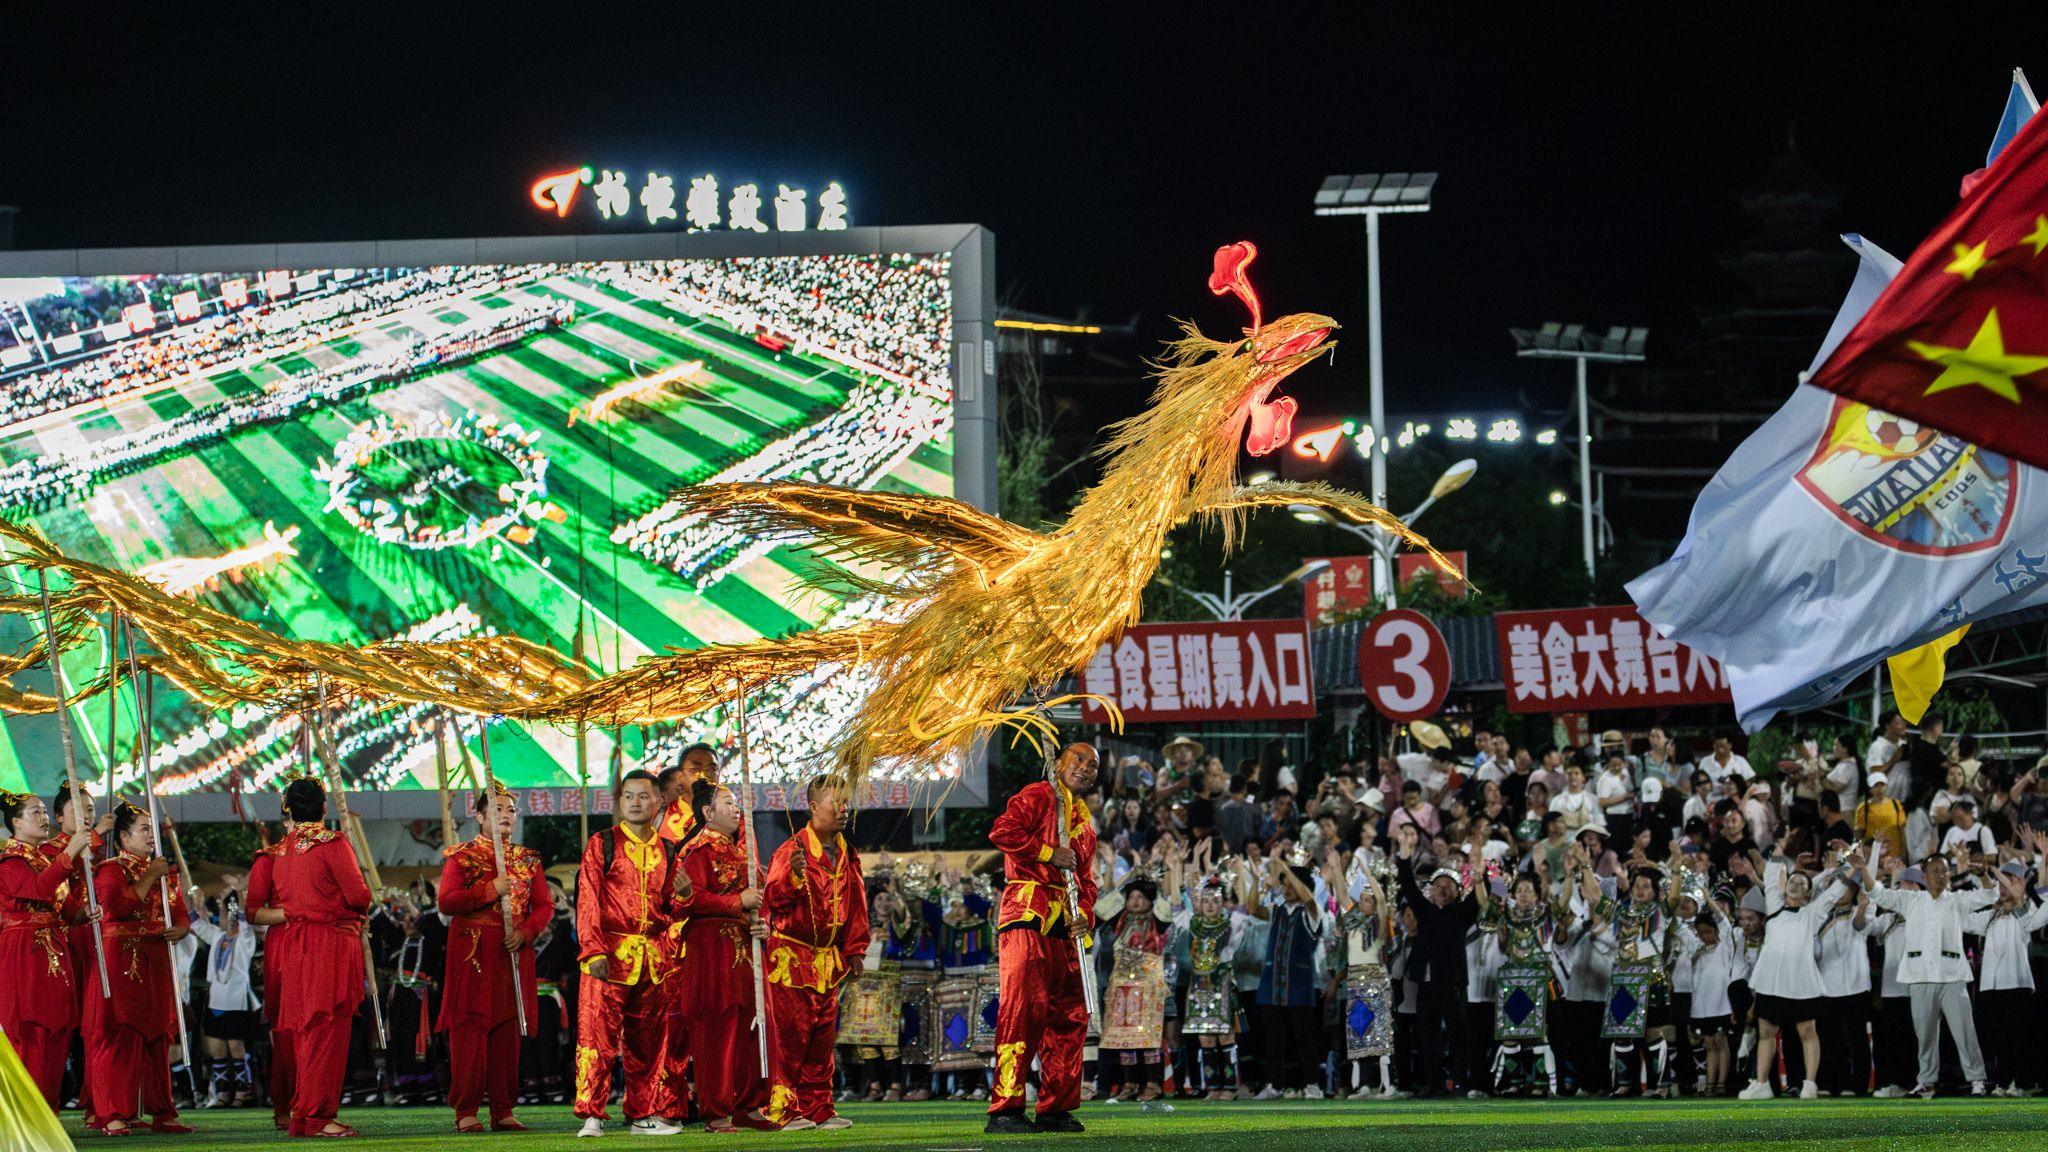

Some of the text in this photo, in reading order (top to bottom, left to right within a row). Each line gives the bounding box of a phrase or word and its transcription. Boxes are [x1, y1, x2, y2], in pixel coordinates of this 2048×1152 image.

[1084, 631, 1310, 713] 美食星期舞入口
[1373, 619, 1436, 713] 3
